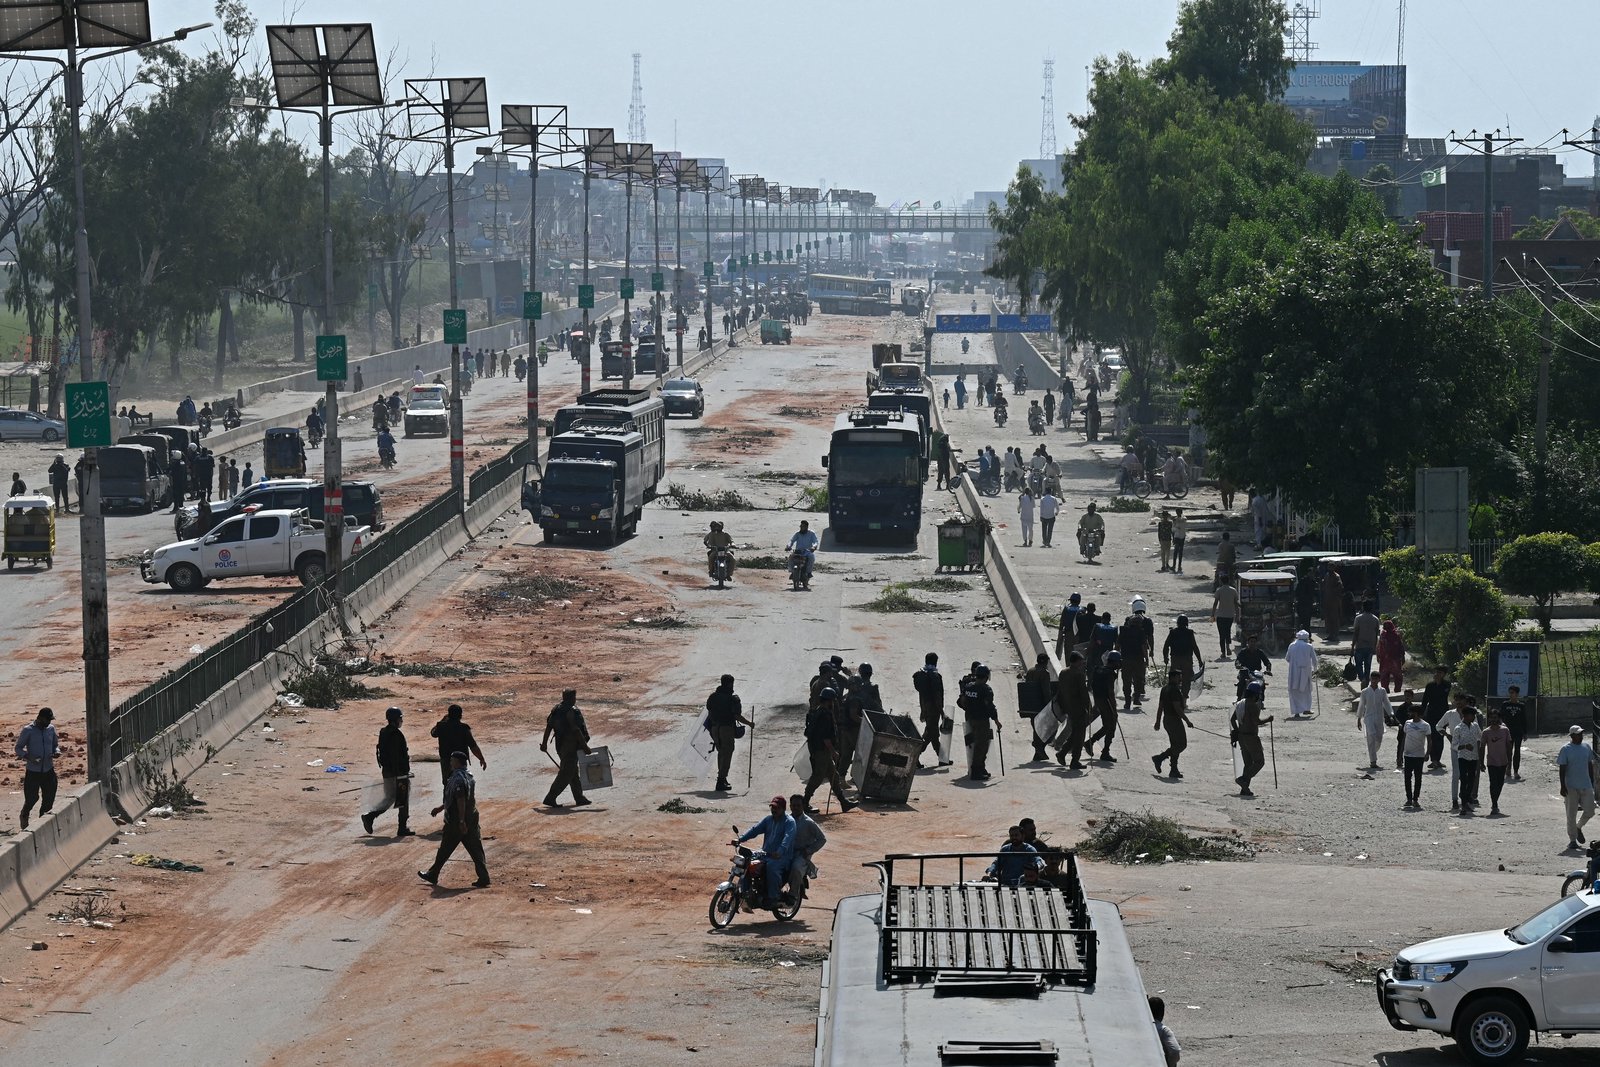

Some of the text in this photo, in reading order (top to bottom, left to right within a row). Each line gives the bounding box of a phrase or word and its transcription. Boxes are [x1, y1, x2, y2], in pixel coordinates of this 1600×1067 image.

[1299, 73, 1312, 87] OF
[1342, 127, 1375, 135] Starting
[215, 560, 238, 568] POLICE
[965, 690, 978, 698] POLICE
